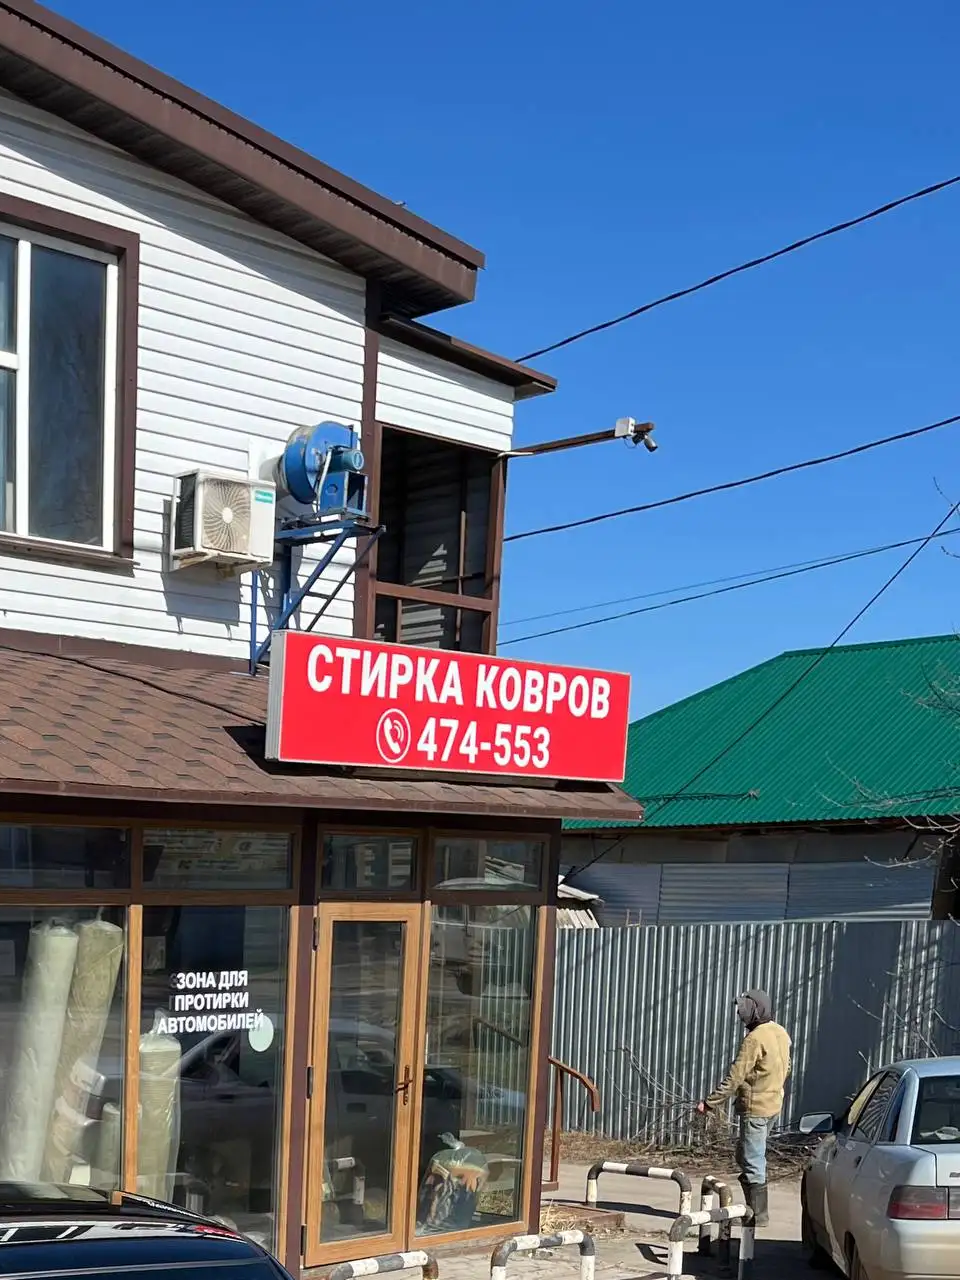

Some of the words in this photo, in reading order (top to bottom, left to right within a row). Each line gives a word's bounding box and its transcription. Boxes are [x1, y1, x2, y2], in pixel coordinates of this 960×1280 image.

[307, 644, 464, 706] СТИРКА
[475, 663, 611, 719] КОВРОВ
[417, 717, 550, 769] 474-553
[176, 971, 216, 990] ЗОНА
[218, 970, 248, 990] ДЛЯ
[174, 992, 249, 1011] ПРОТИРКИ
[157, 1008, 264, 1034] АВТОМОБИЛЕЙ
